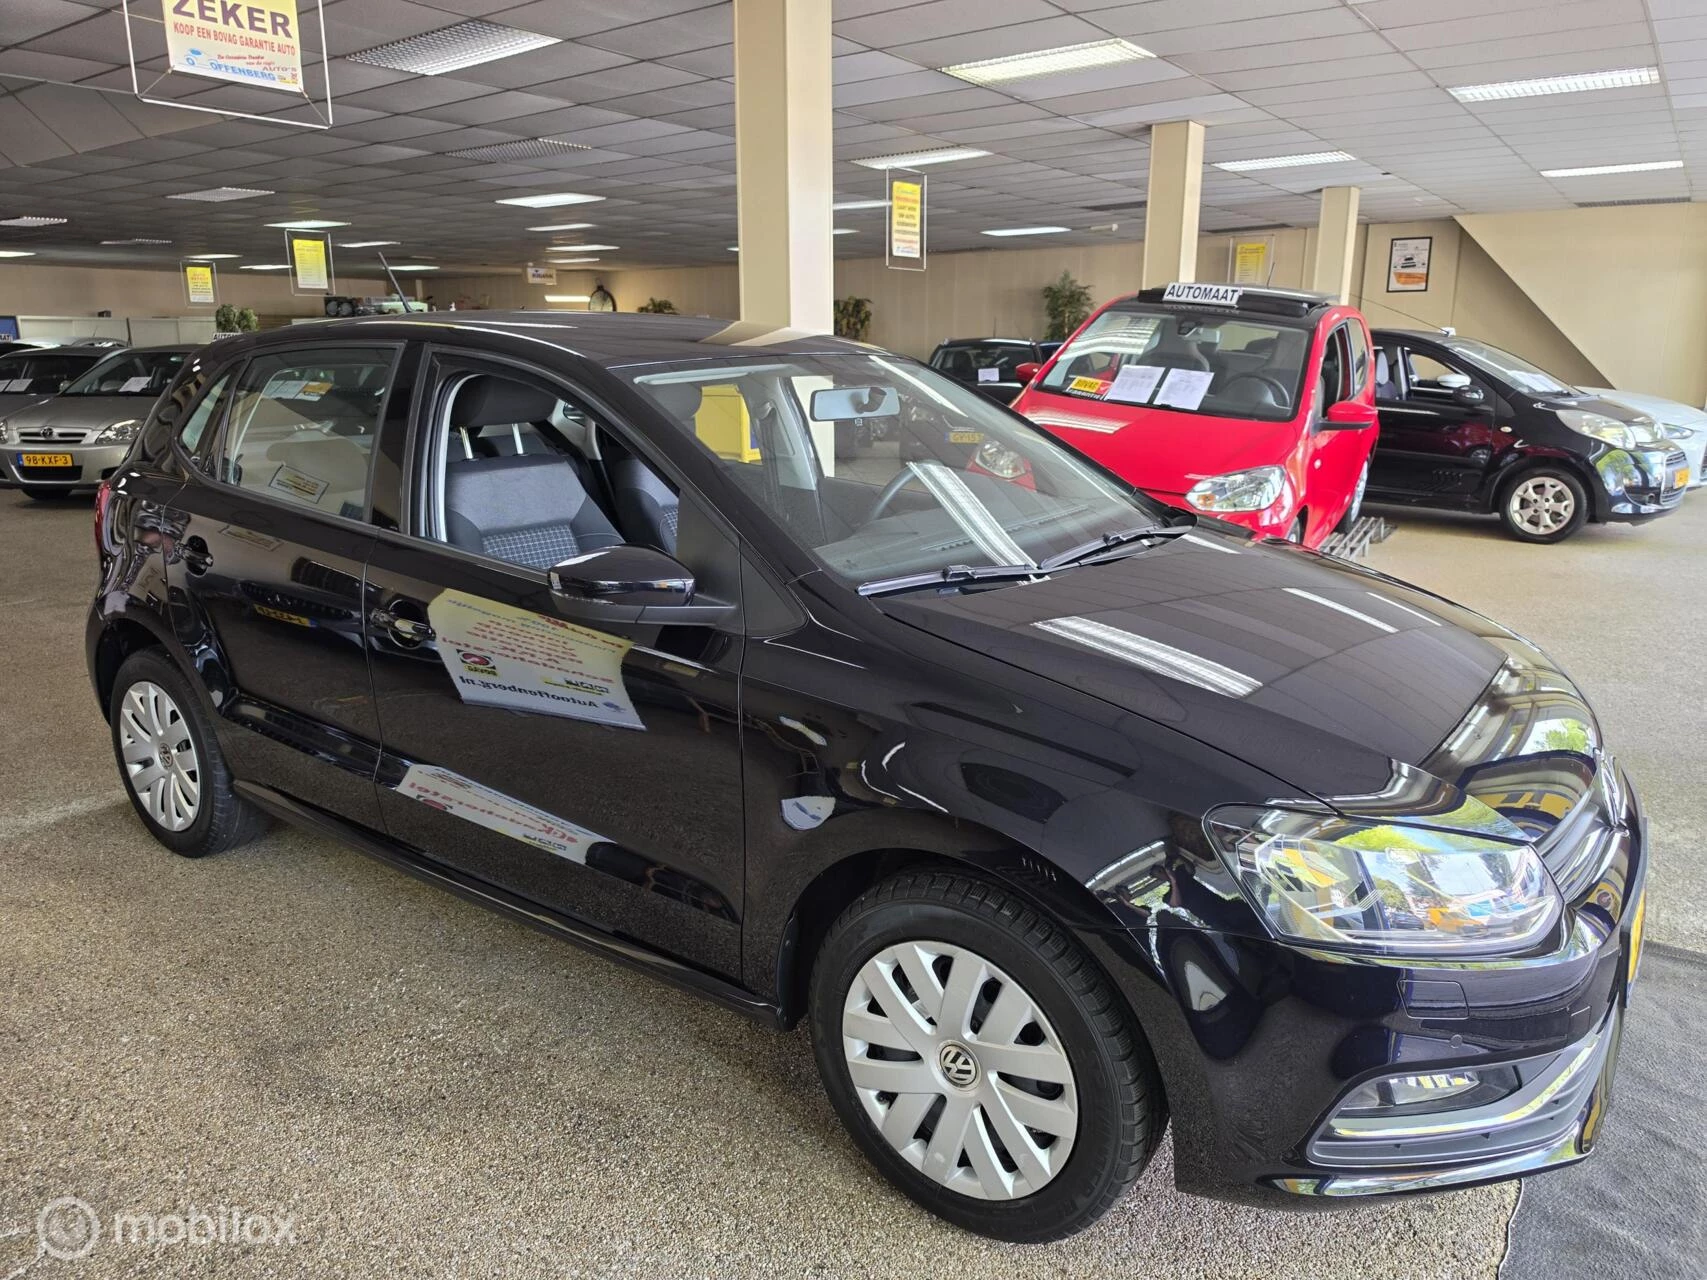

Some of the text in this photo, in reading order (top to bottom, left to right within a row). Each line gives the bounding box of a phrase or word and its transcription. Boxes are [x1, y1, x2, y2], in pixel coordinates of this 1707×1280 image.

[173, 0, 293, 38] ZEKER
[174, 21, 296, 56] KOOP EEN BOVAG GARANTIE AUTO
[209, 62, 276, 81] OFFENBERG
[1167, 285, 1240, 304] AUTOMAAT
[25, 455, 68, 465] 98-KXF-3
